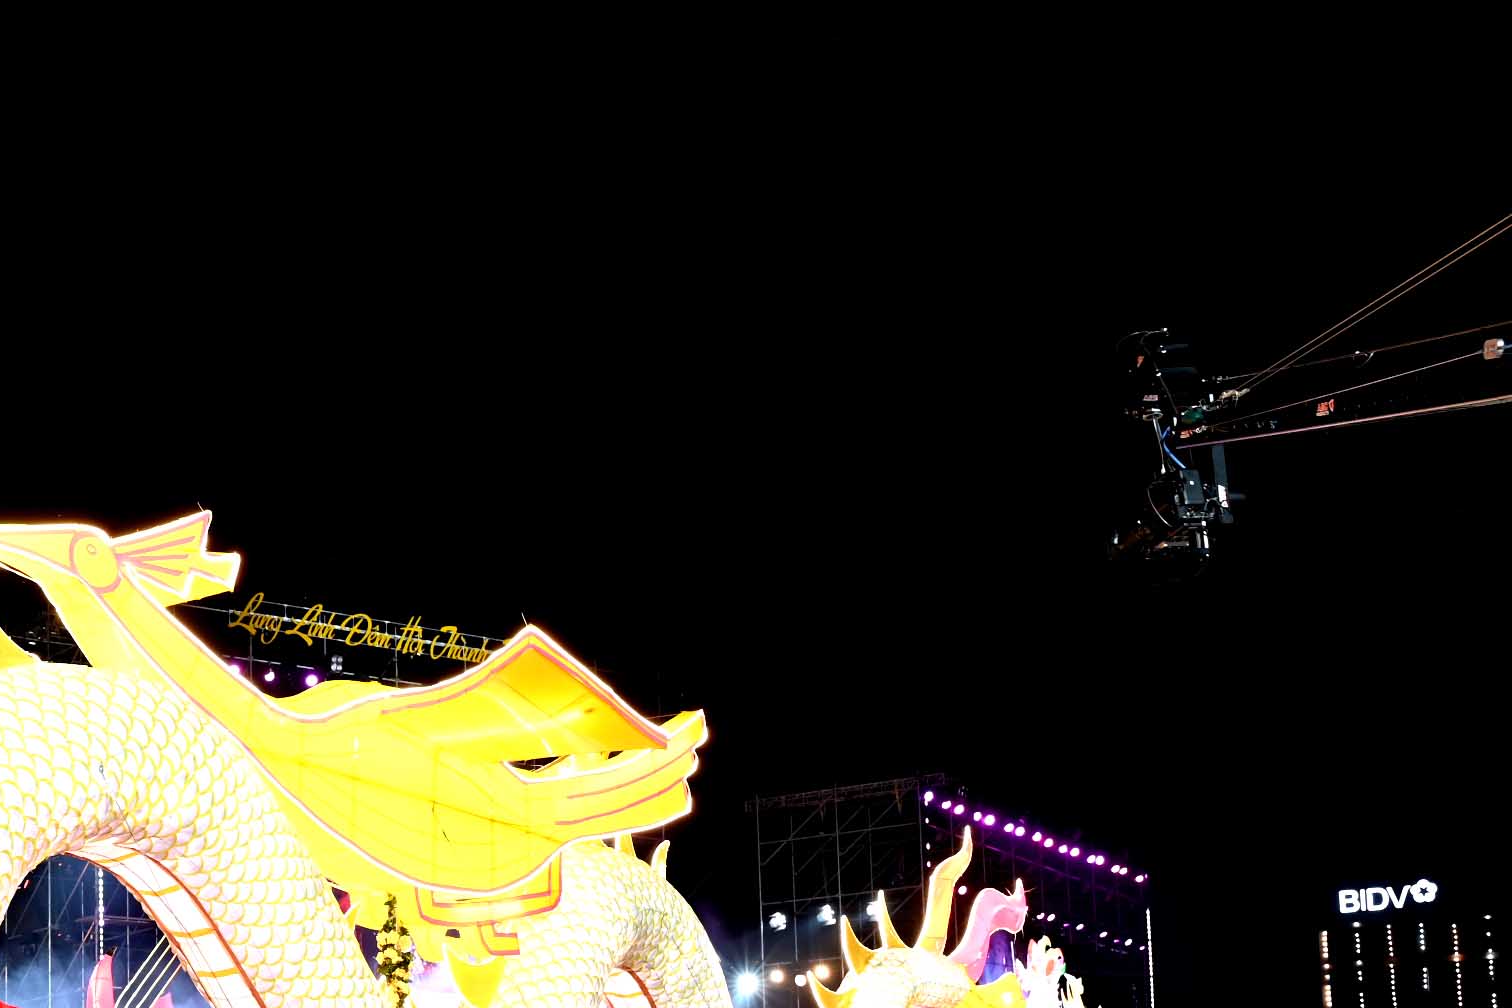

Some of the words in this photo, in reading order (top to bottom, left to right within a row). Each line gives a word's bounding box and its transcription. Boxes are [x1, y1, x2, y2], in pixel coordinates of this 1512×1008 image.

[285, 604, 336, 647] Linh
[340, 612, 394, 647] Đêm
[396, 616, 425, 660] Hội
[1338, 885, 1412, 914] BIDV
